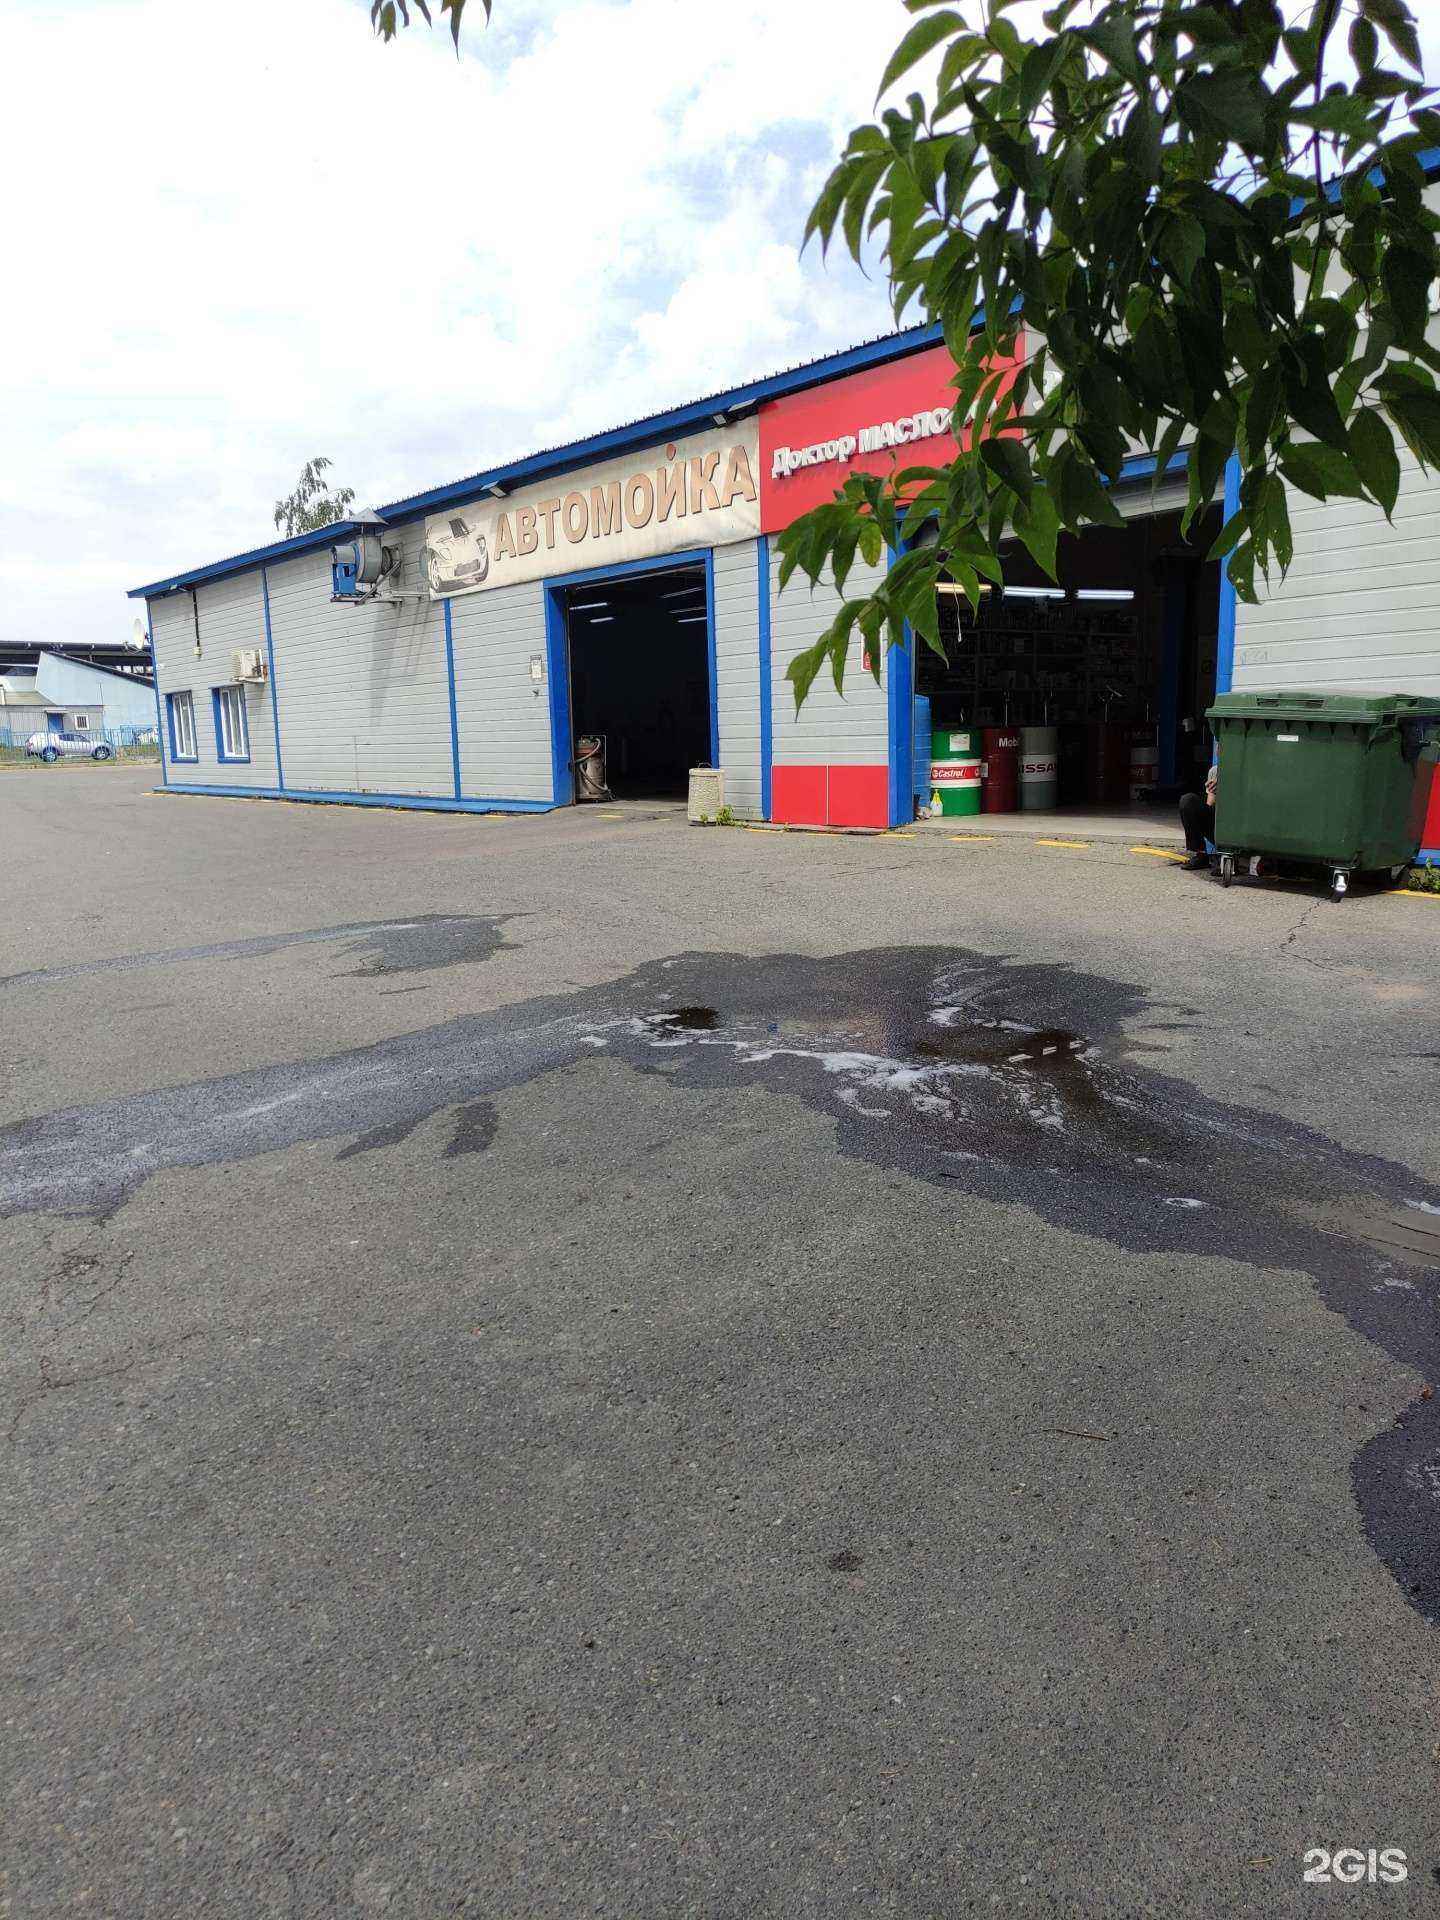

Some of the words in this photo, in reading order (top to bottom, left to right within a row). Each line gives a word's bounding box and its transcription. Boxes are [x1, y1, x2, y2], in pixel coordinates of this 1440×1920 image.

[772, 435, 857, 480] Доктор
[494, 443, 758, 562] АВТОМОЙКА
[938, 767, 966, 779] Castrol
[1018, 763, 1057, 775] ISSA
